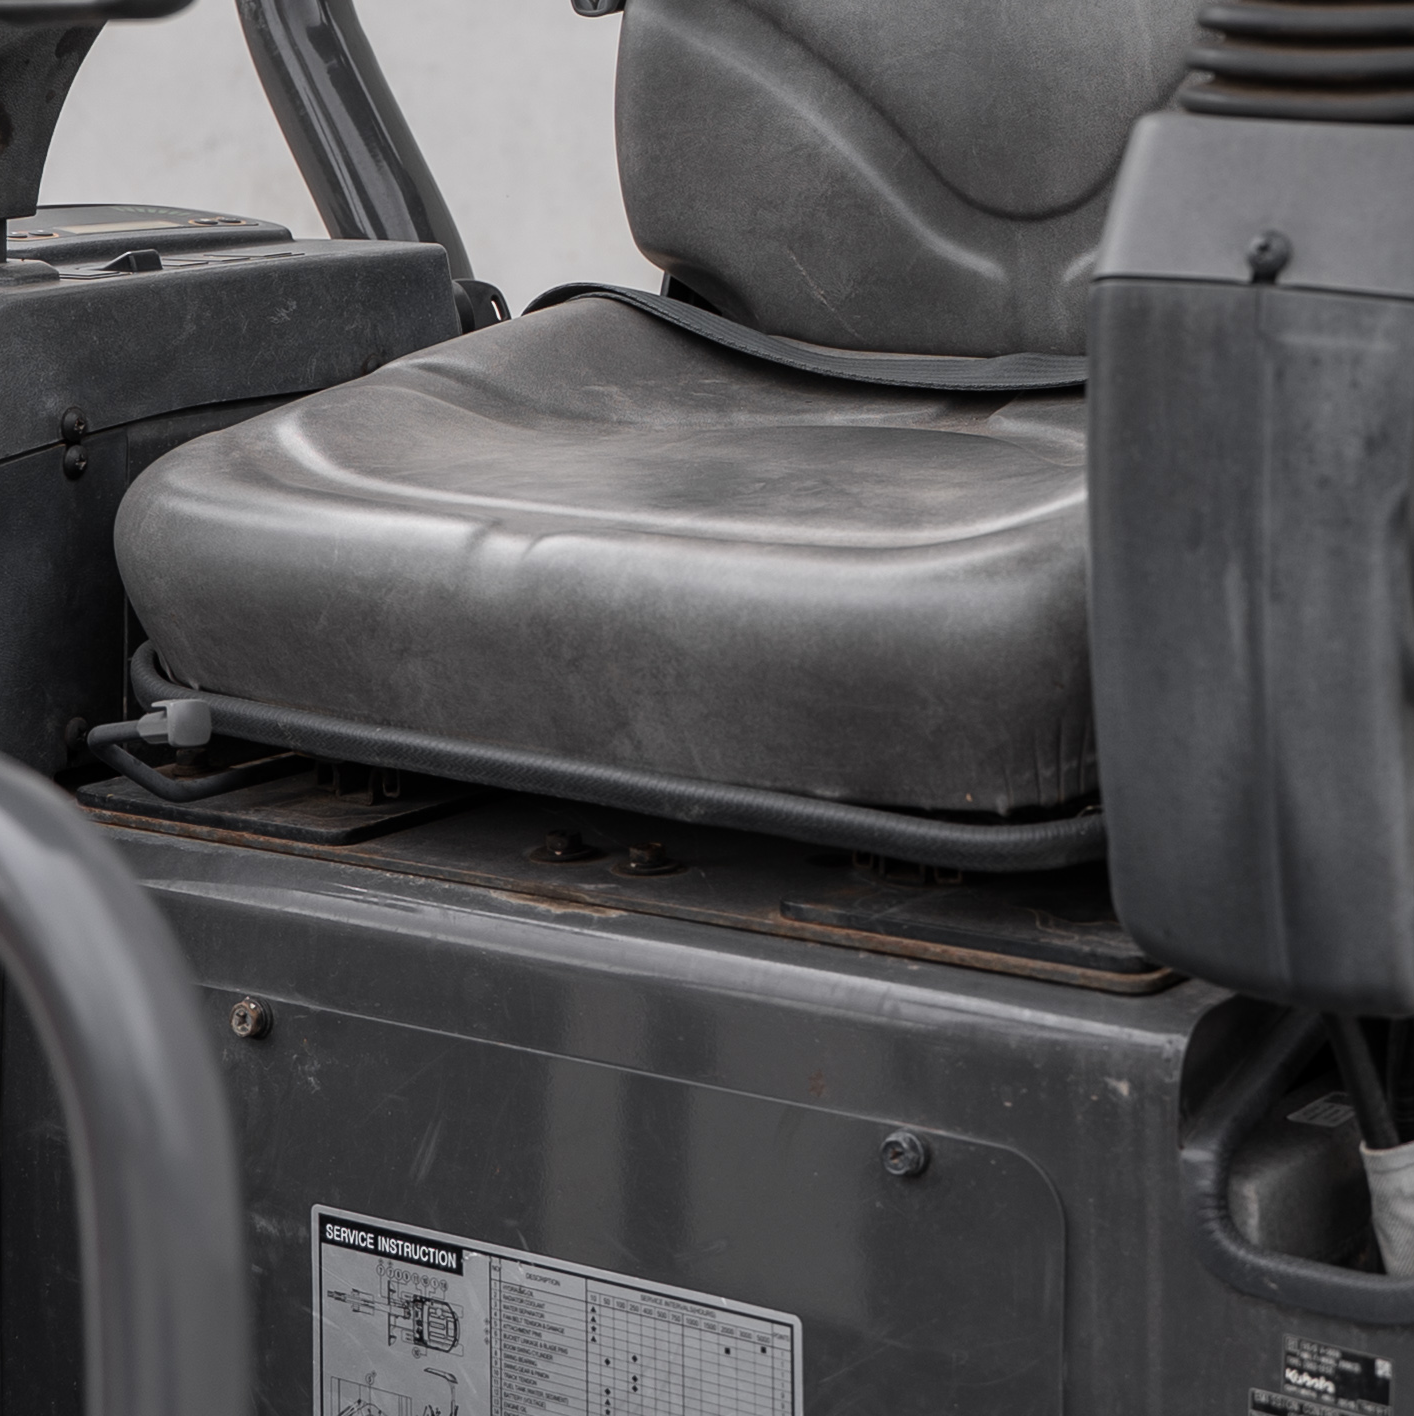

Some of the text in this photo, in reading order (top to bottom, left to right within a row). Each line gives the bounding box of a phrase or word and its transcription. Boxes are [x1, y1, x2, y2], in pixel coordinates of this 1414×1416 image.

[325, 1223, 457, 1269] SERVICE INSTRUCTION
[525, 1272, 561, 1286] DESCRIPTION
[603, 1297, 611, 1305] 50
[629, 1303, 639, 1312] 250
[671, 1314, 681, 1322] 750
